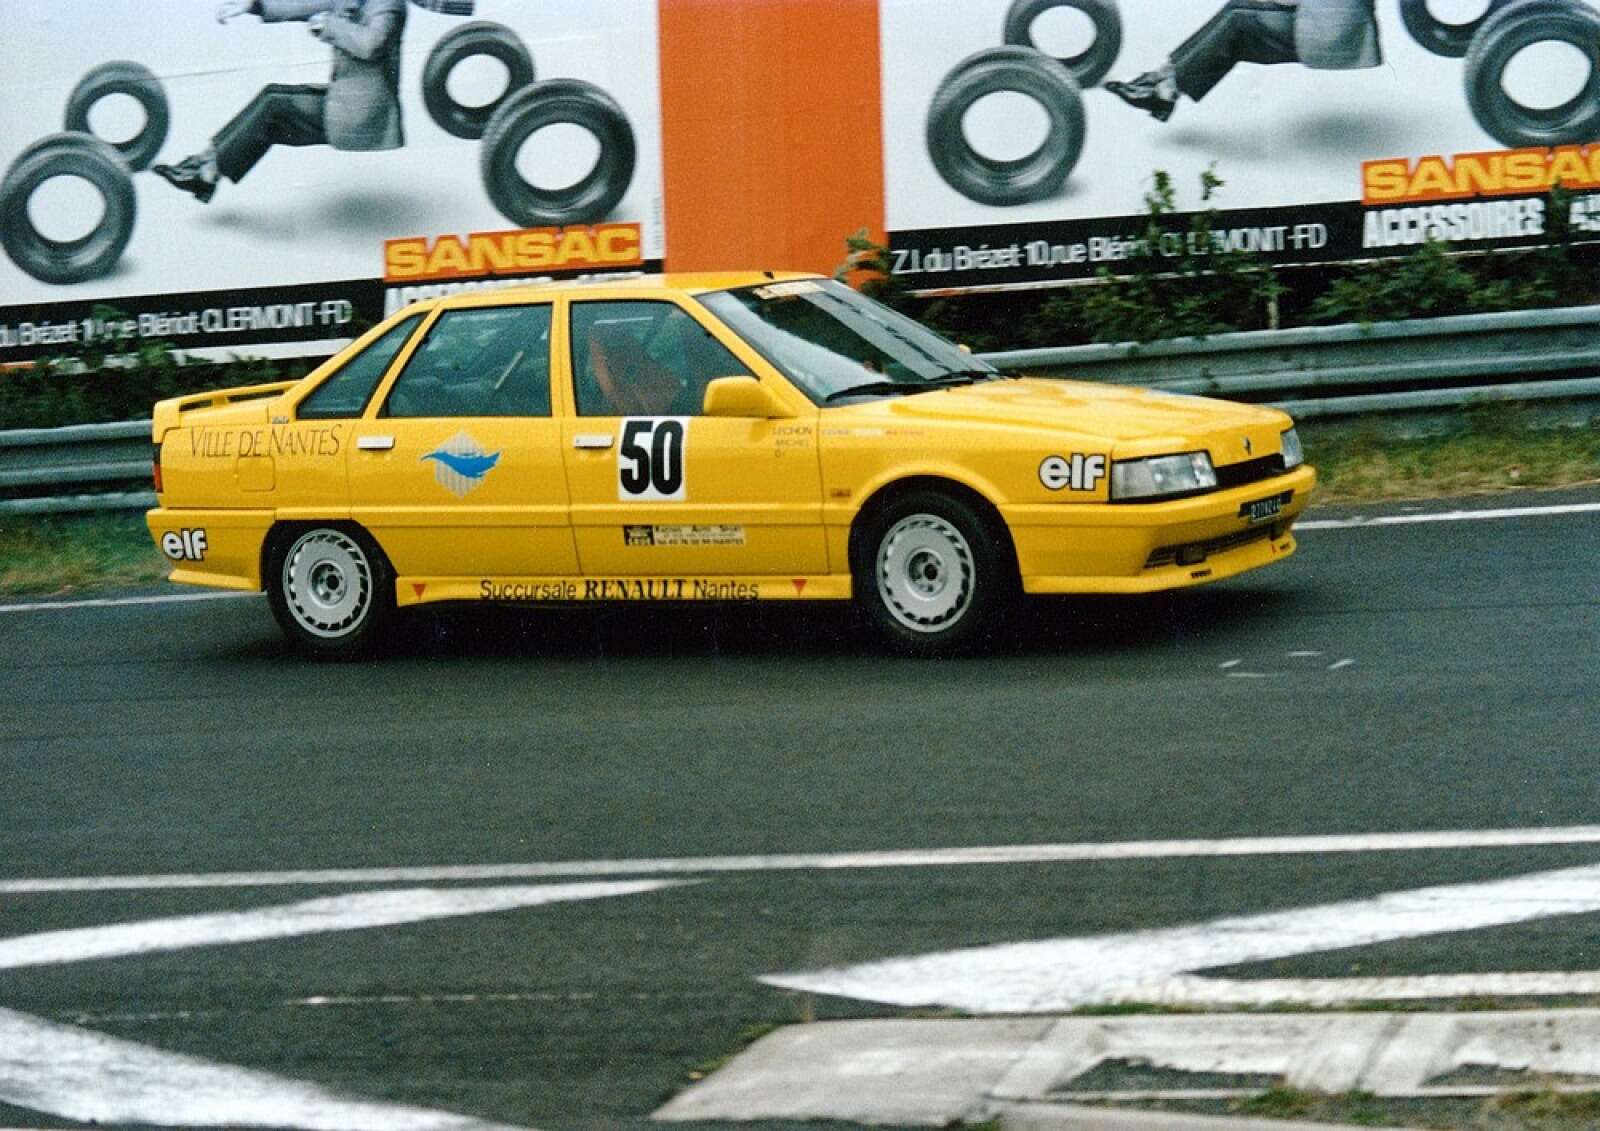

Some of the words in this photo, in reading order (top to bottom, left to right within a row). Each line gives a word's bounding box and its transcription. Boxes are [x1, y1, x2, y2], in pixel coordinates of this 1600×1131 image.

[1365, 150, 1600, 199] SANSA
[386, 226, 641, 277] SANSAC
[190, 424, 234, 458] VILLE
[237, 430, 264, 458] DE
[268, 423, 343, 457] NANTES
[620, 419, 684, 495] 50
[1038, 452, 1106, 492] elf
[161, 527, 209, 561] elf
[479, 579, 577, 600] Succursale
[583, 578, 688, 600] RENAULT
[693, 578, 759, 600] Nantes
